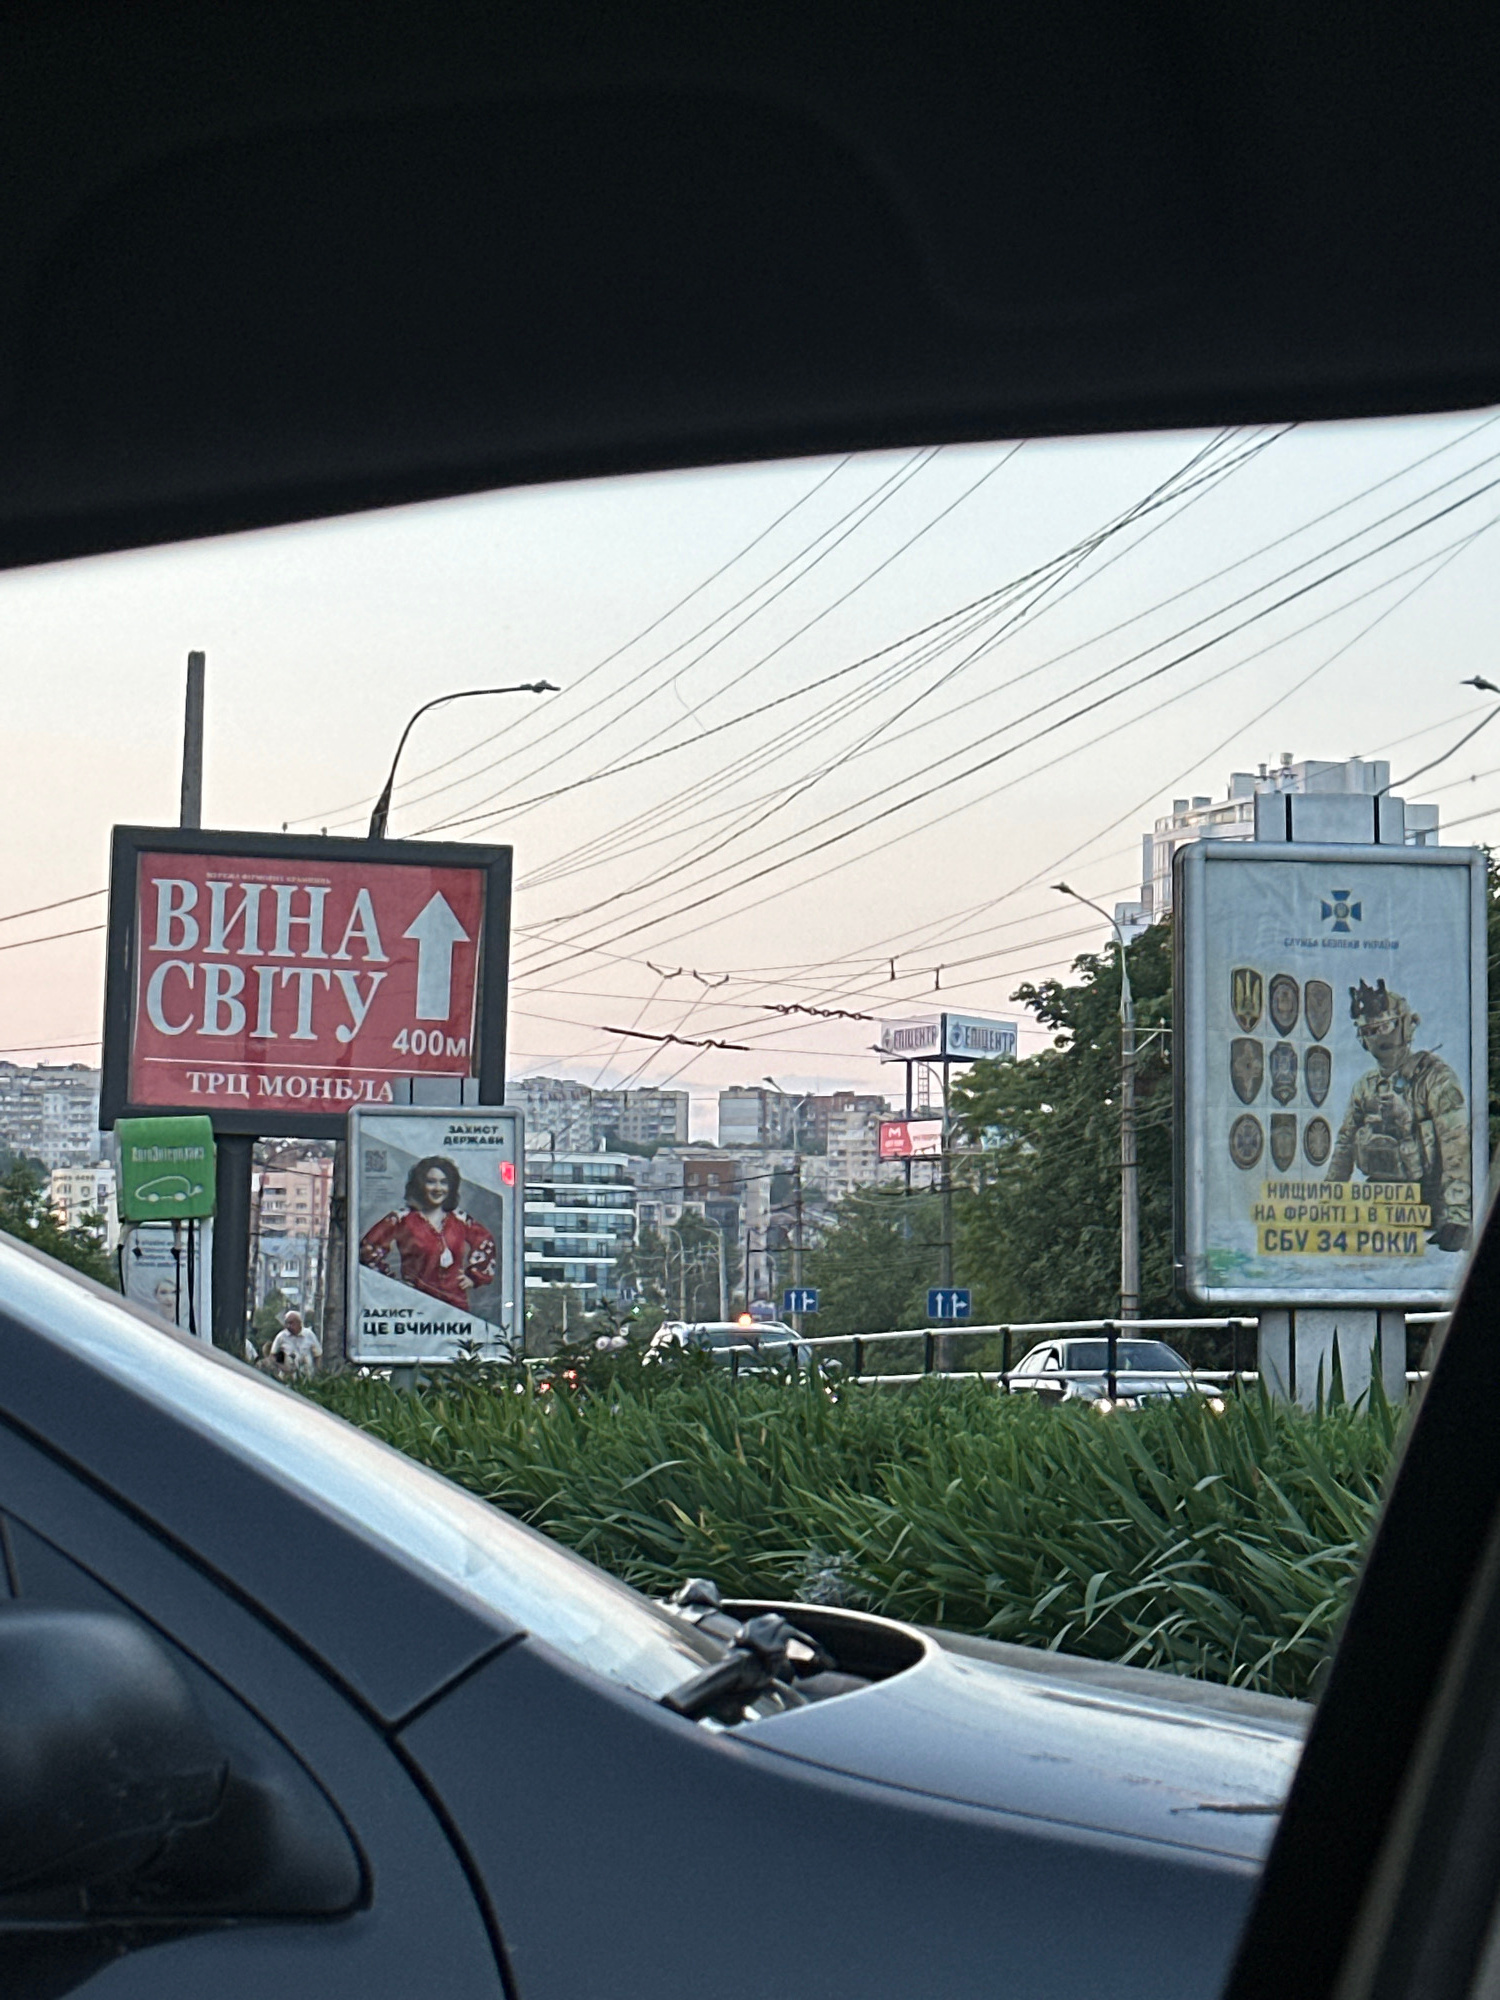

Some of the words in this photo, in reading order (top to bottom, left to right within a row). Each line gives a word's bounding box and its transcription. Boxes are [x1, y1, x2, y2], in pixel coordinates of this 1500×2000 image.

[148, 878, 390, 962] ВИНА
[146, 960, 388, 1044] СВІТУ
[186, 1071, 249, 1097] ТРЦ
[449, 1125, 499, 1135] ЗАХИСТ
[443, 1136, 504, 1146] ДЕРЖАВИ
[1268, 1182, 1343, 1202] НИЩИМО
[1351, 1184, 1416, 1201] ВОРОГА
[1254, 1205, 1276, 1222] НА
[1284, 1205, 1346, 1222] ФРОНТІ
[1368, 1207, 1378, 1223] В
[1387, 1207, 1428, 1224] ТИЛУ
[1264, 1229, 1309, 1252] СБУ
[1317, 1230, 1348, 1253] 34
[1357, 1230, 1418, 1254] РОКИ
[363, 1308, 414, 1318] ЗАХИСТ
[364, 1322, 389, 1337] ЦЕ
[394, 1322, 472, 1335] ВЧИНКИ
